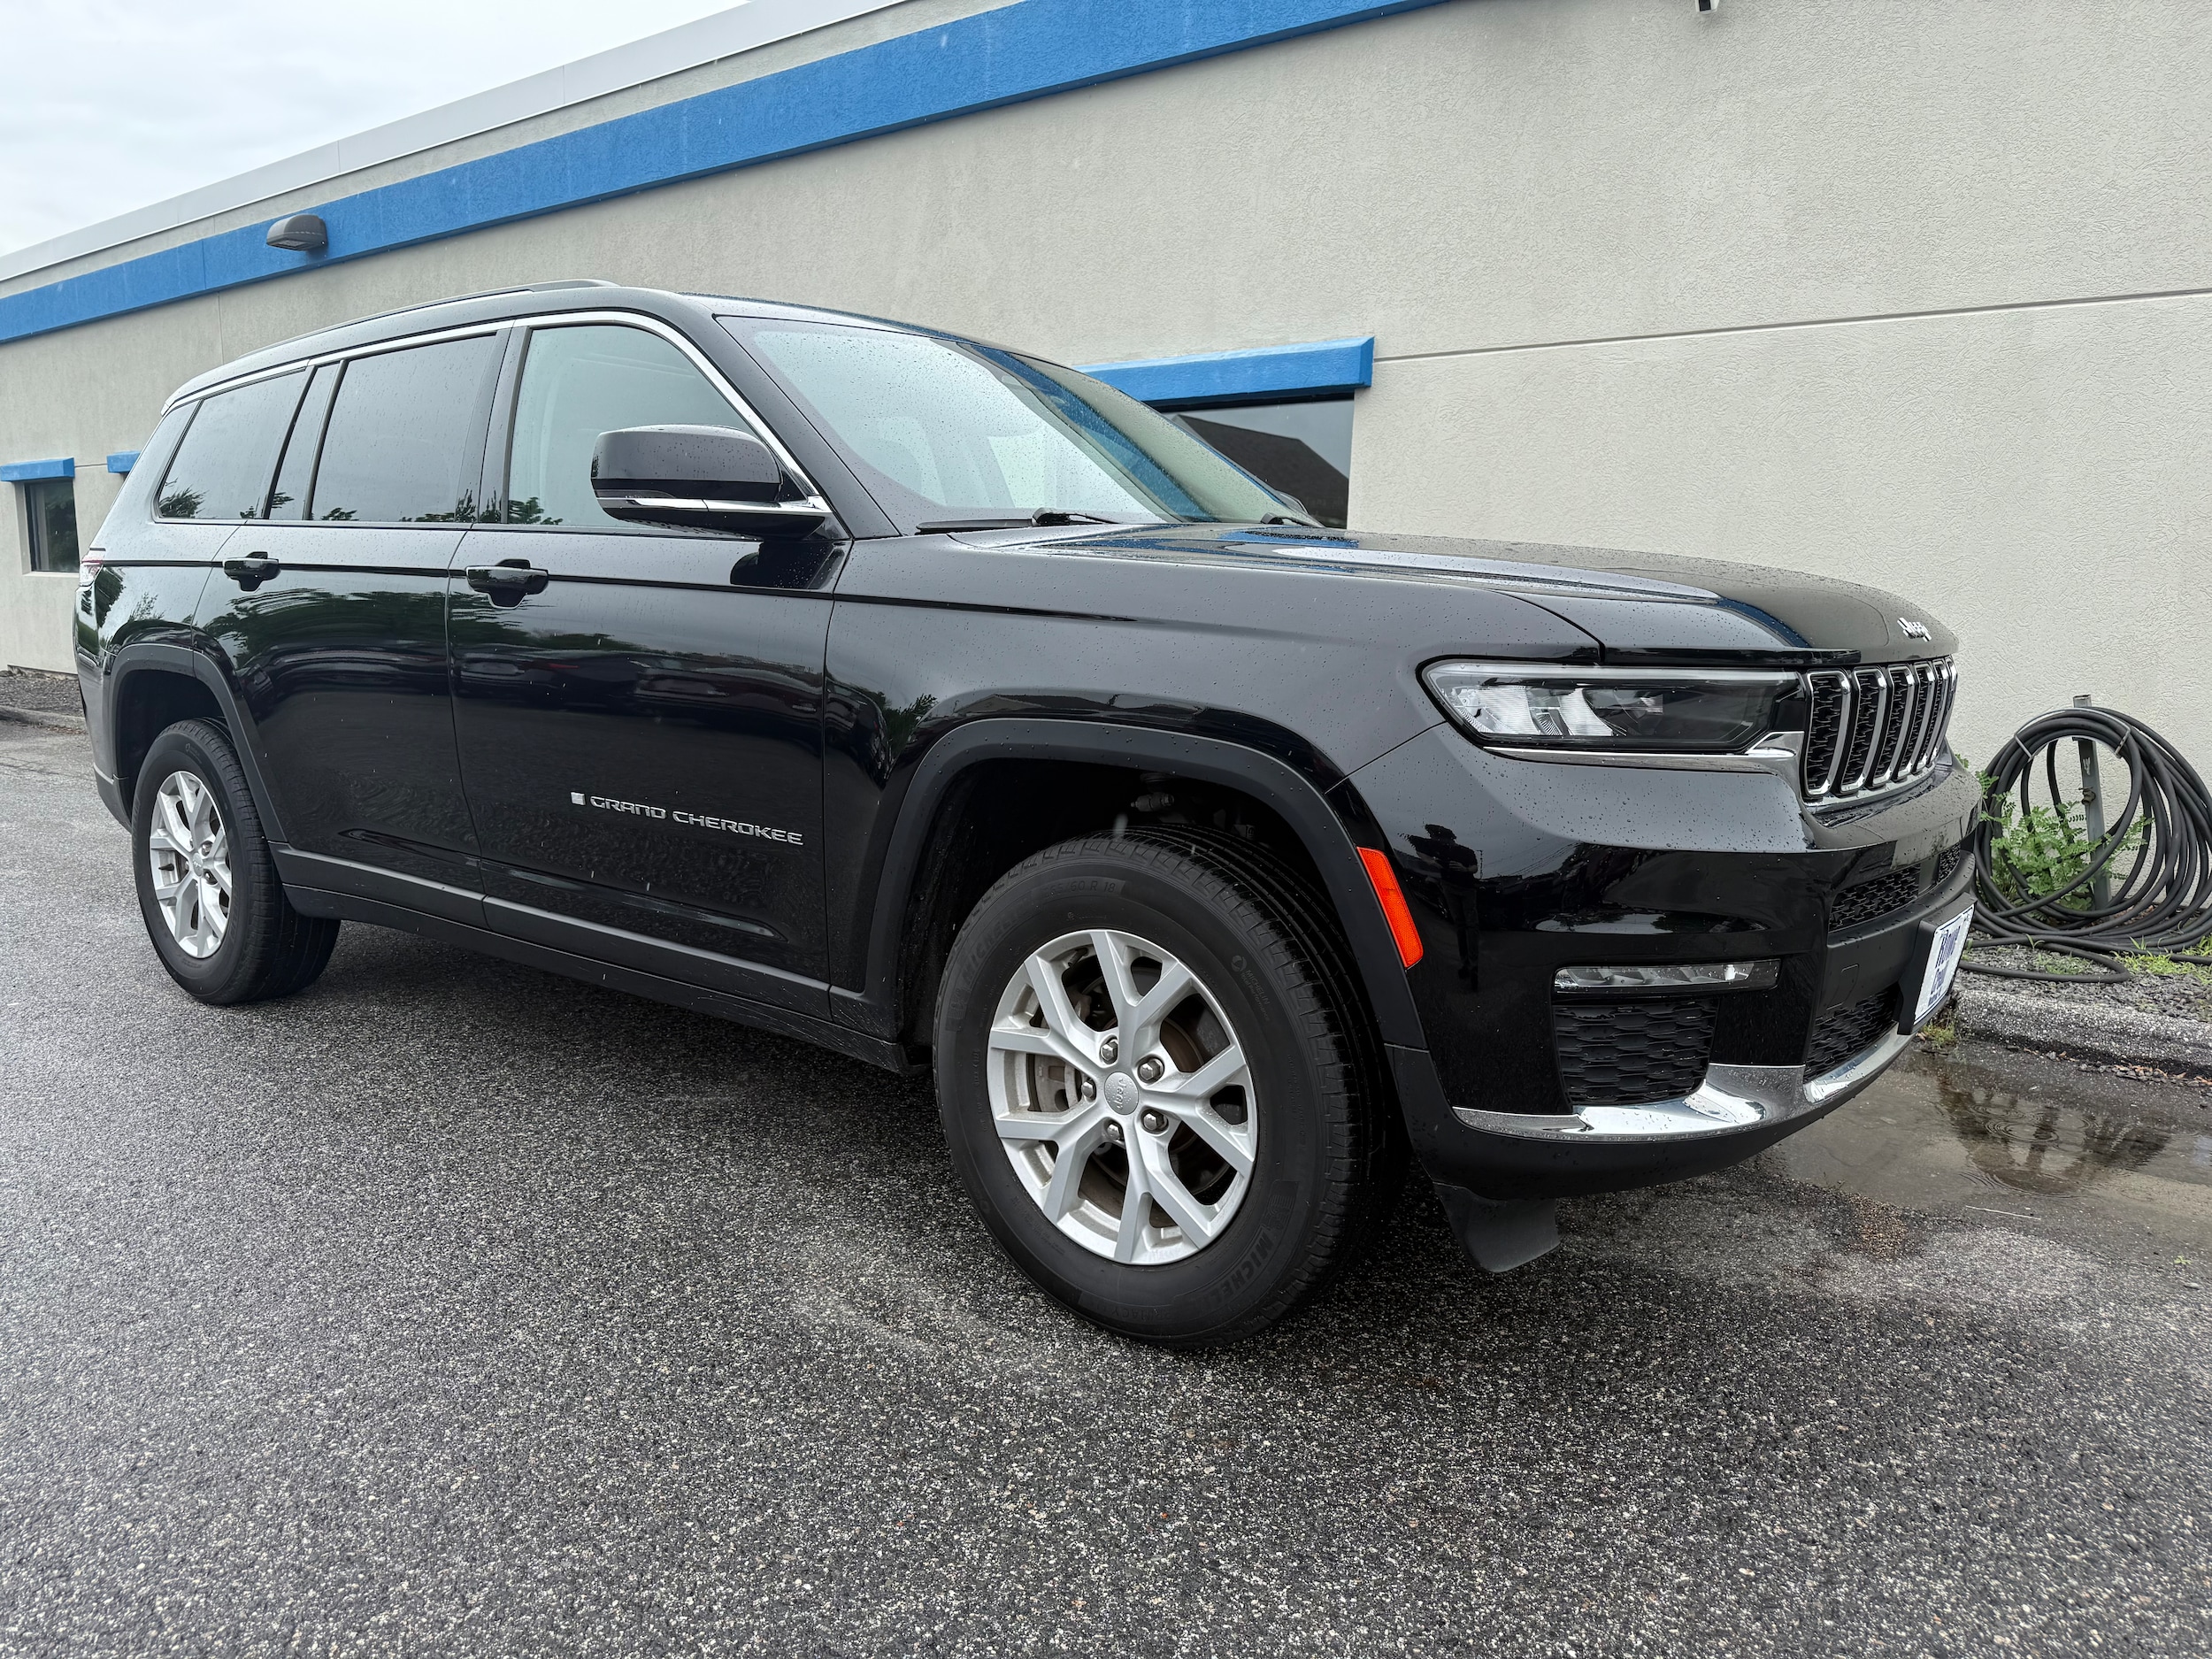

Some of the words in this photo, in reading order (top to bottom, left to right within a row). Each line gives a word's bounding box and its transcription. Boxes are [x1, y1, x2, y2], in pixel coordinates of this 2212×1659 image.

[590, 795, 666, 819] GRAND
[672, 810, 803, 846] CHEROKEE
[1245, 969, 1271, 1006] MICHELIN
[1114, 1077, 1127, 1110] Jeep
[1182, 1232, 1274, 1310] MICHEL
